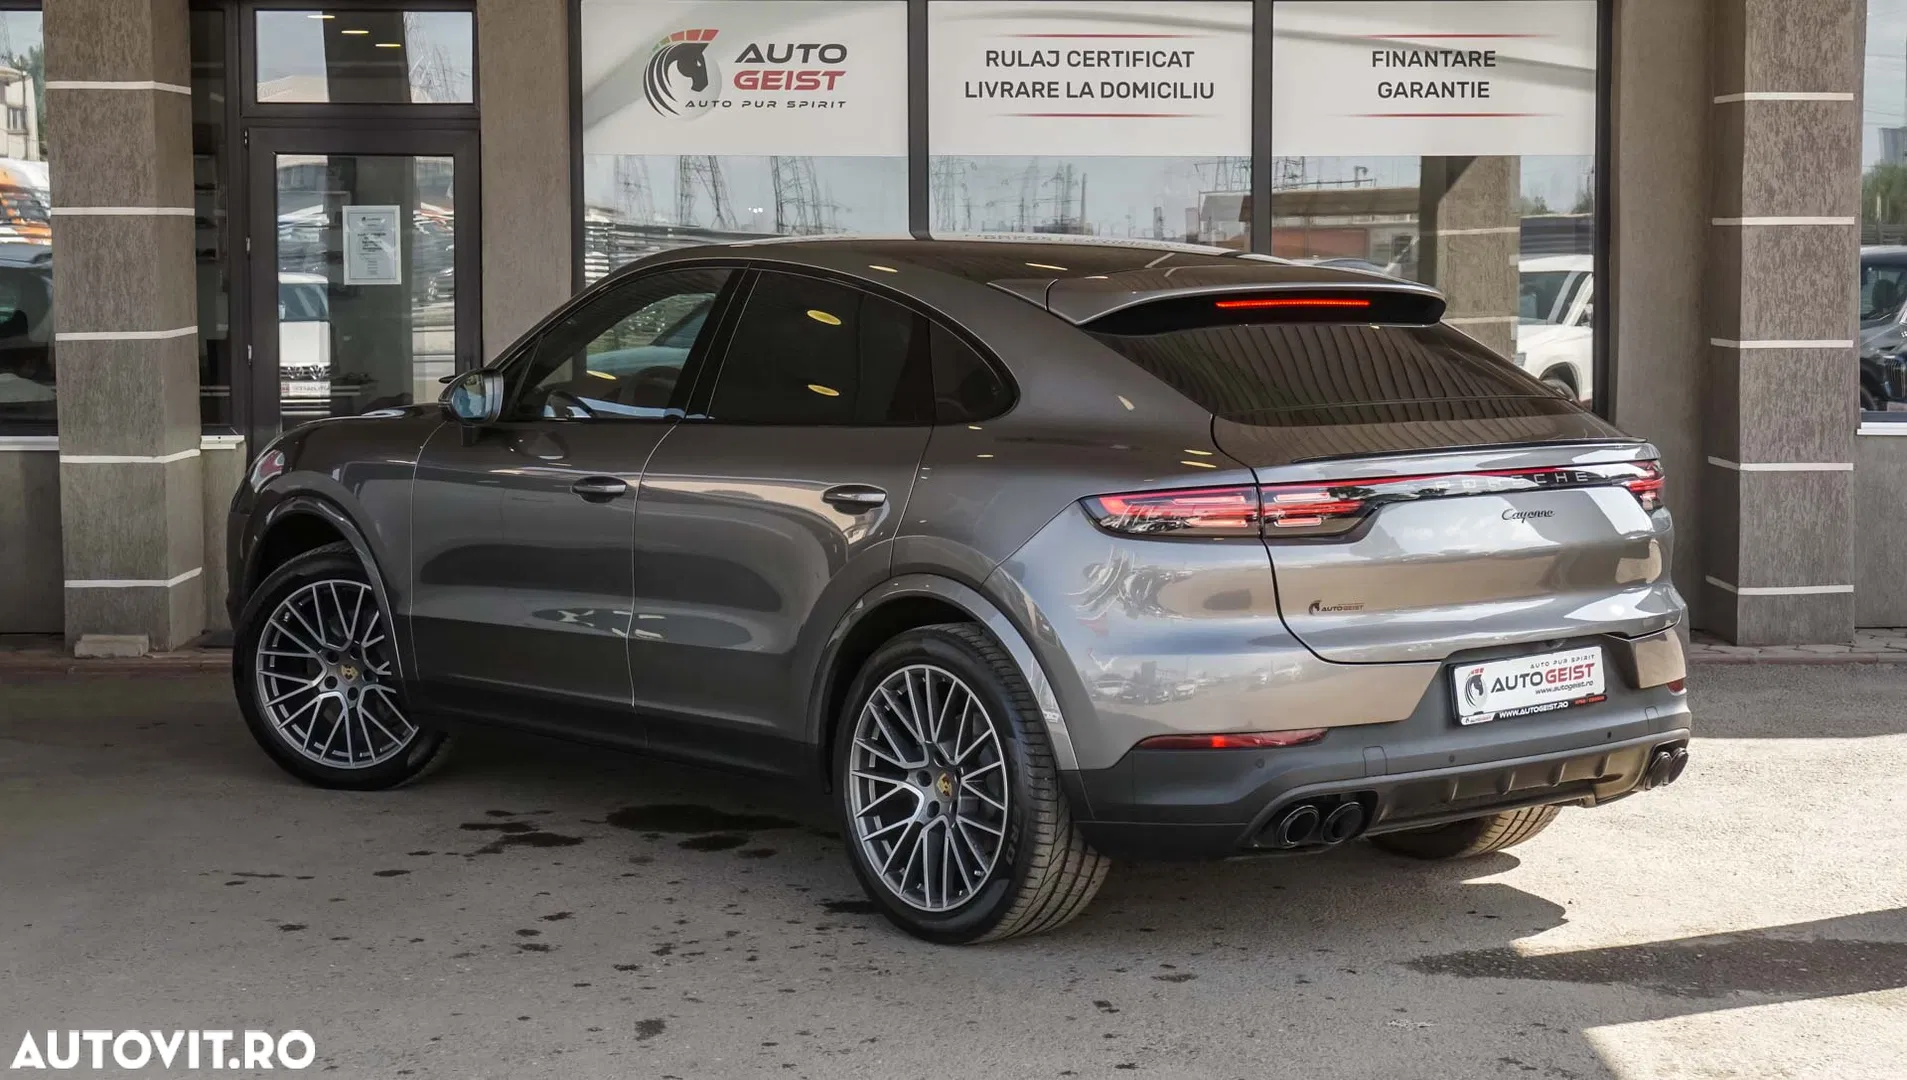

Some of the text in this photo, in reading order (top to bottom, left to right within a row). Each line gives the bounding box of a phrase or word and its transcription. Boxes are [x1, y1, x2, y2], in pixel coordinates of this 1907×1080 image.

[734, 43, 848, 64] AUTO
[985, 50, 1195, 68] RULAJ CERTIFICAT
[1372, 50, 1496, 68] FINANTARE
[733, 70, 847, 91] GEIST
[965, 81, 1215, 99] LIVRARE LA DOMICILIU
[1377, 81, 1490, 99] GARANTIE
[685, 100, 847, 108] AUTO PUR SPIRIT
[1501, 508, 1555, 523] Cayenne
[1530, 661, 1550, 669] AUTO
[1571, 654, 1595, 663] SPIRIT
[1490, 662, 1595, 694] AUTOGEIST
[1535, 680, 1594, 695] www.autogeist.ro
[1499, 701, 1569, 719] WWW.AUTOGEIST.RO
